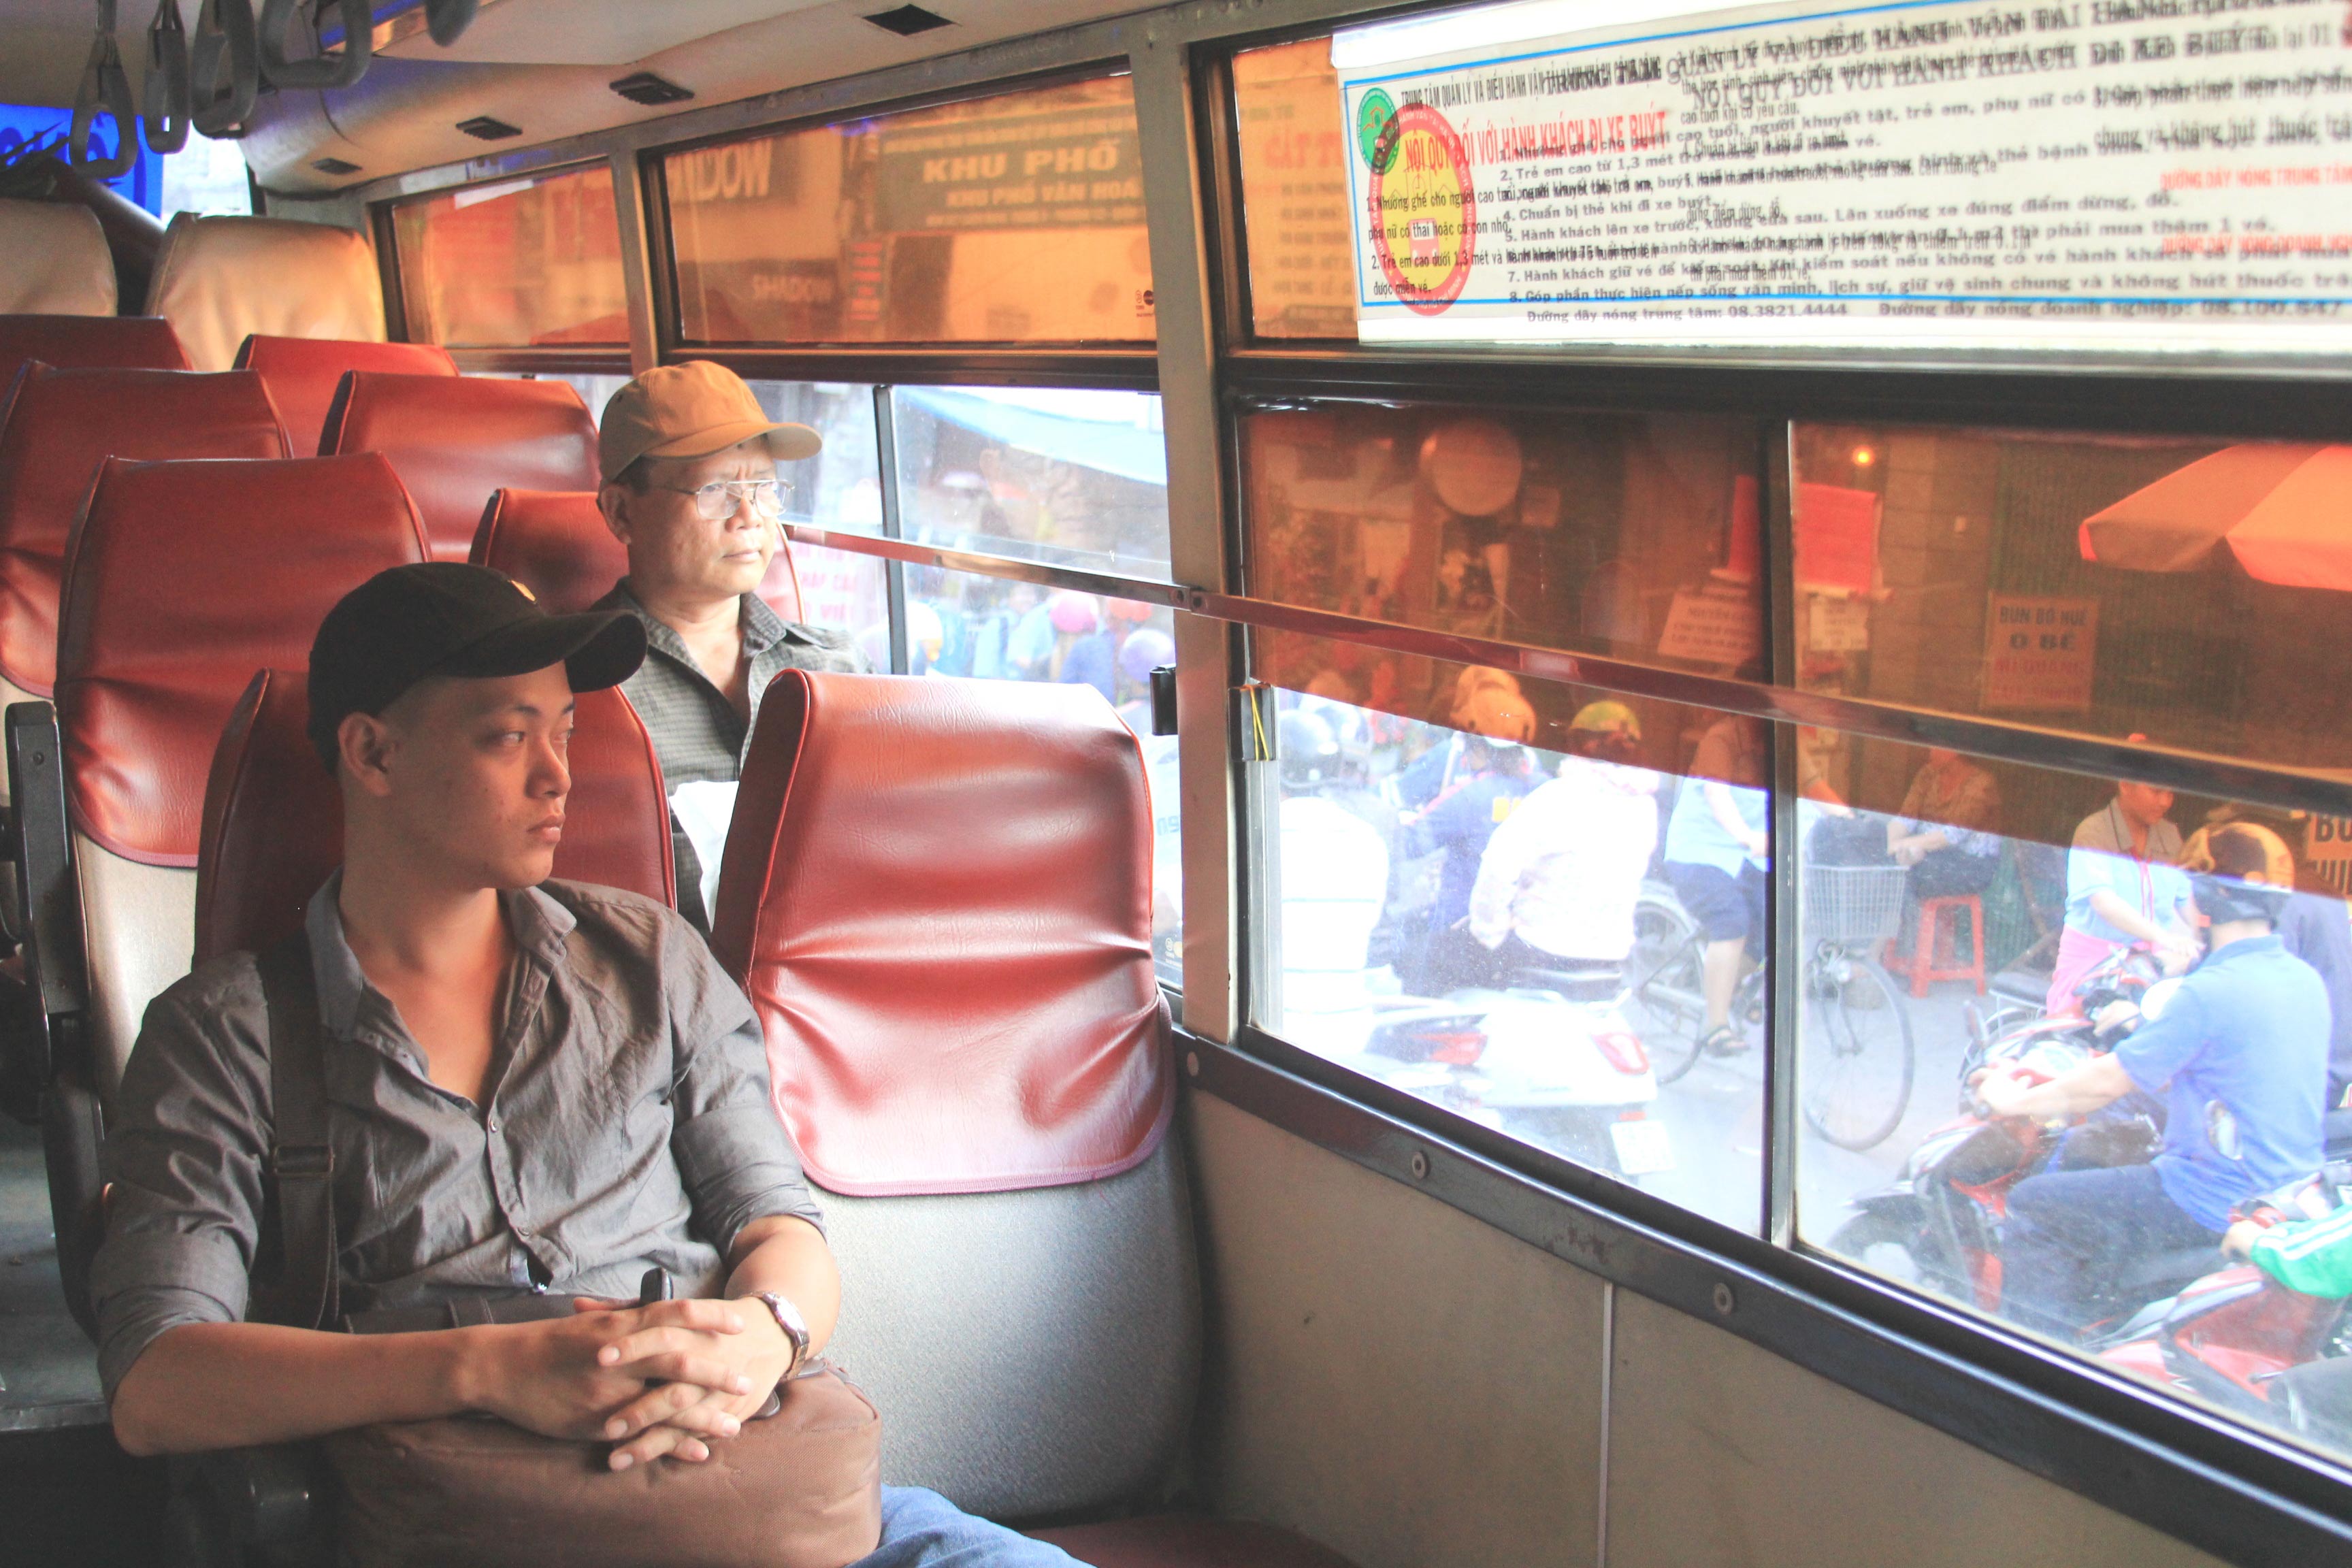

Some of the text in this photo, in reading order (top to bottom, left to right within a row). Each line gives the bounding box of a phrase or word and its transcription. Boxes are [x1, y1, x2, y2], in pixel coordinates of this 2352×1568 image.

[921, 138, 1120, 184] KHU PHỐ
[1516, 165, 1538, 180] Trẻ
[1544, 167, 1563, 178] em
[1568, 163, 1591, 174] cao
[1478, 190, 1494, 203] cao
[1413, 222, 1429, 239] thai
[1522, 227, 1554, 241] Hành
[1560, 226, 1601, 239] khách
[1607, 223, 1627, 236] lên
[1633, 225, 1648, 235] xe
[1472, 250, 1489, 265] mét
[1524, 269, 1557, 282] Hành
[1563, 267, 1603, 280] khách
